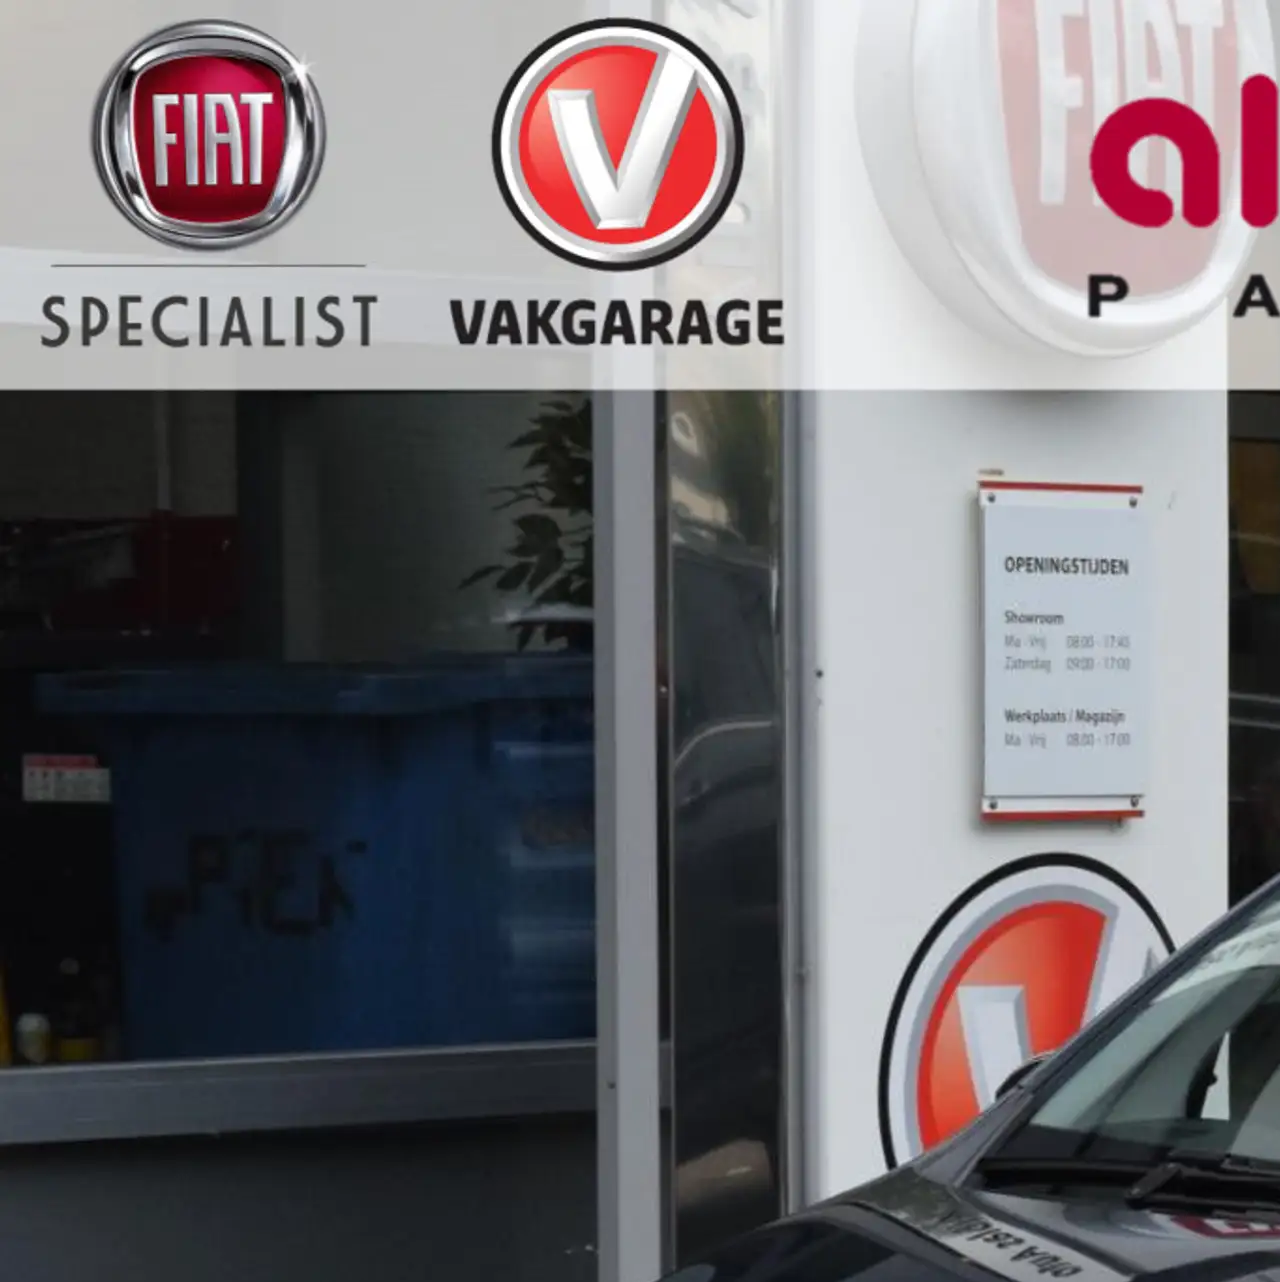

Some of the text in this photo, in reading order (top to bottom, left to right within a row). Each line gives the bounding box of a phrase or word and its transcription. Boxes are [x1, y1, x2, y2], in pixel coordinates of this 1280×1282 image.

[1004, 556, 1129, 575] OPENINGSTIJDEN
[1004, 610, 1064, 625] Showroom
[1004, 708, 1066, 724] Werkplaats
